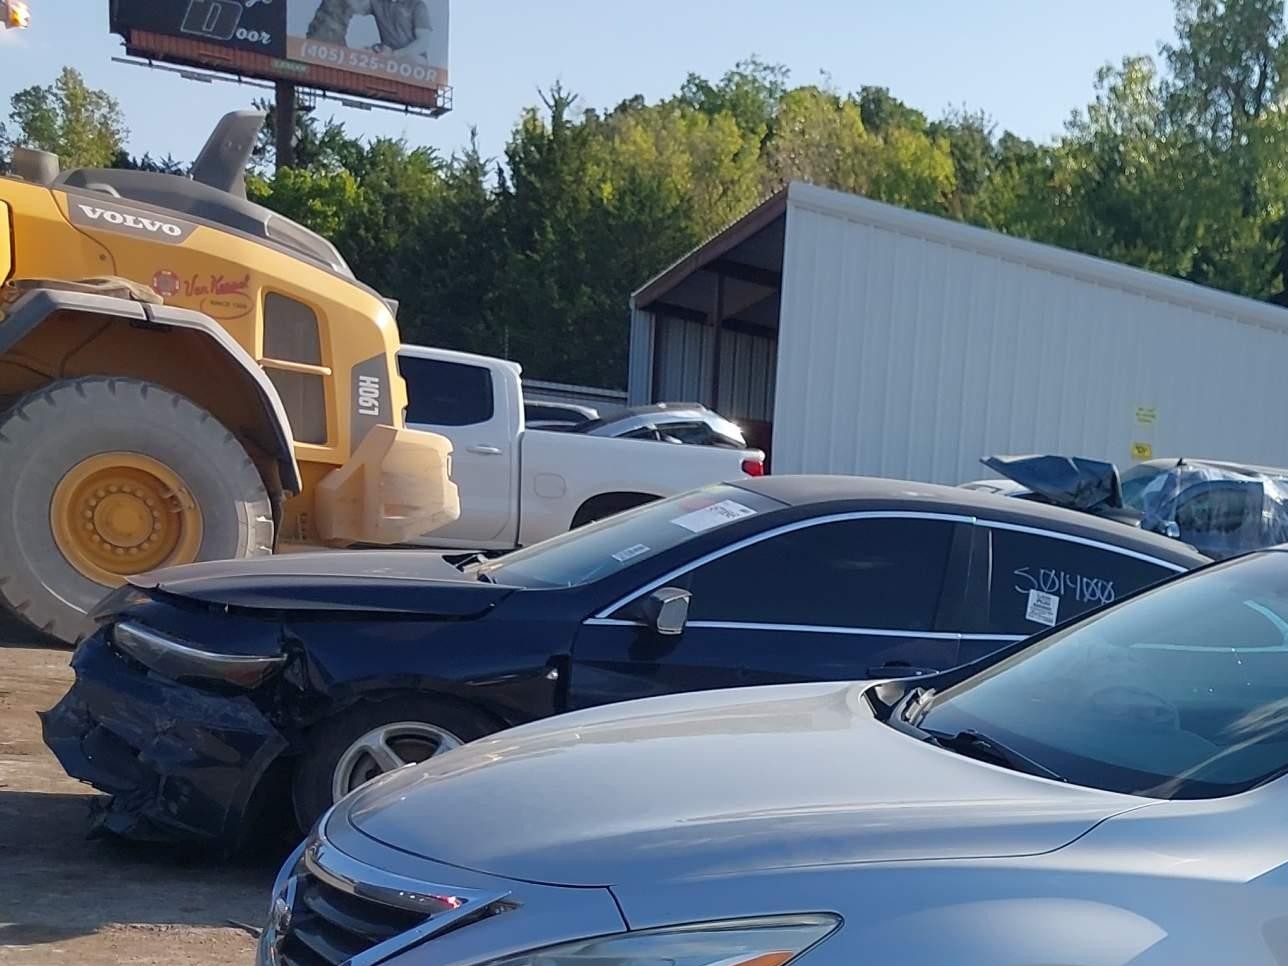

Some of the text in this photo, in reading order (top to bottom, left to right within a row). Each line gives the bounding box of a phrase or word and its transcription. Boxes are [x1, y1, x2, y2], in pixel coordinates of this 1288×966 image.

[301, 43, 438, 82] (405) 525-DOOR
[78, 204, 182, 236] VOLVO
[358, 375, 380, 416] L90H
